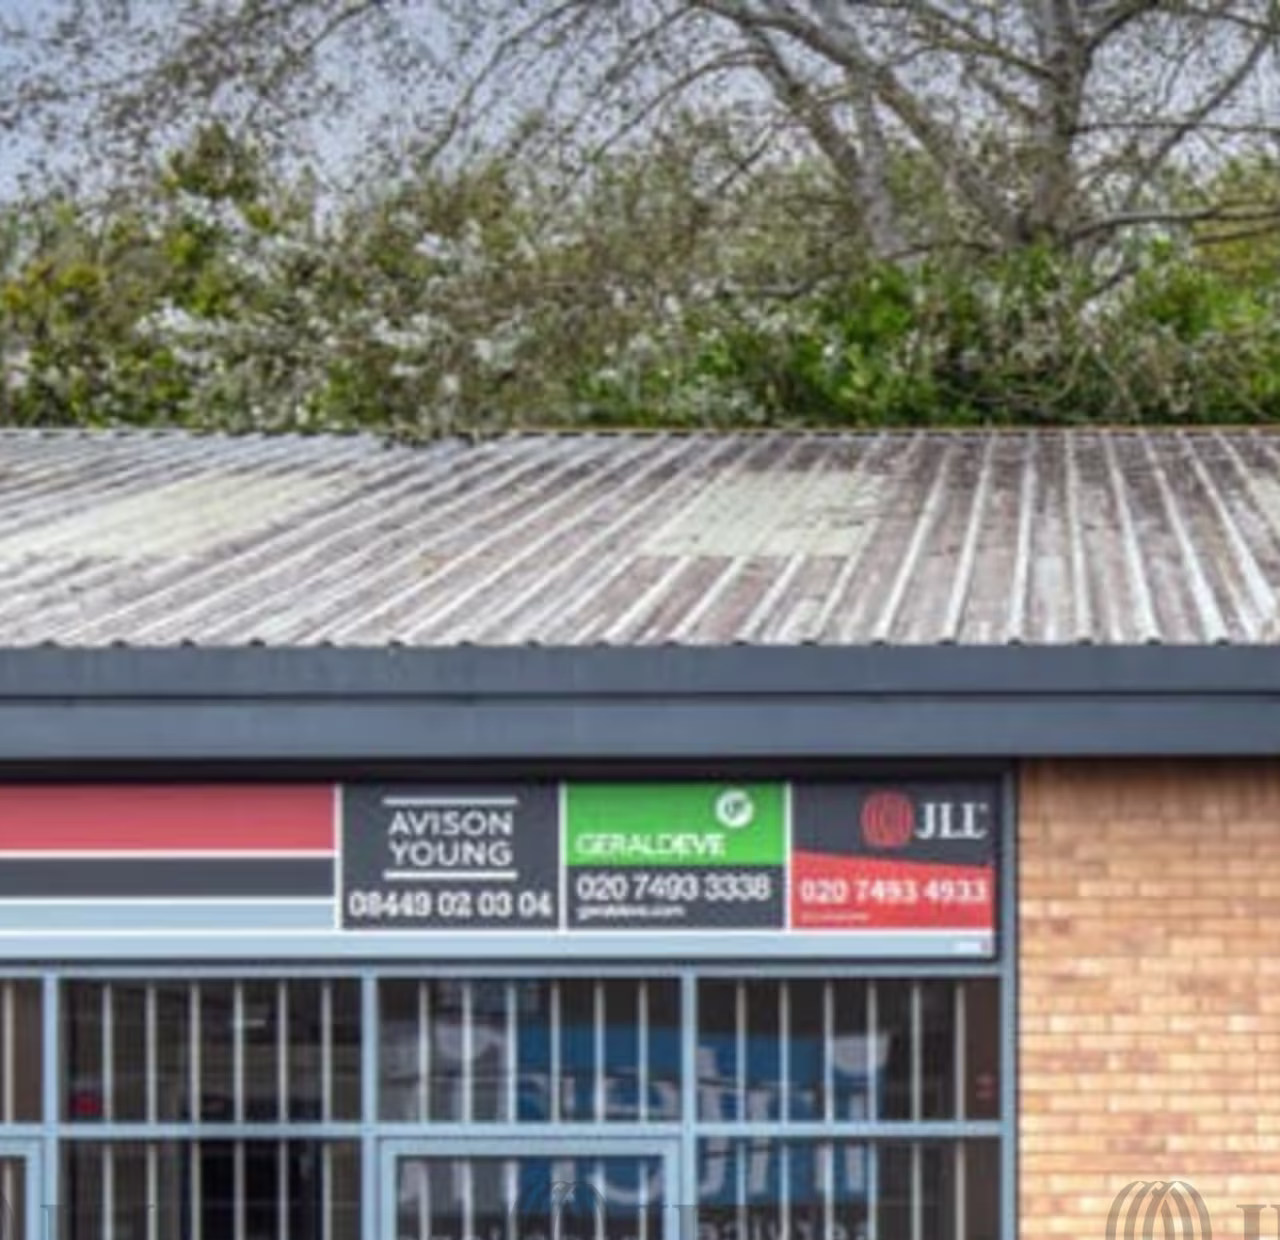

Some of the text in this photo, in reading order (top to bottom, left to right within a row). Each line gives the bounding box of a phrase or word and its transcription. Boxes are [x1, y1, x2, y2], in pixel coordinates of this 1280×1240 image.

[388, 810, 513, 836] AVISON
[915, 802, 983, 840] JLL
[388, 840, 514, 867] YOUNG
[576, 872, 770, 901] 020 7493 3338
[800, 878, 849, 904] 020
[437, 889, 473, 917] 02
[477, 889, 514, 917] 03
[517, 889, 554, 917] 04
